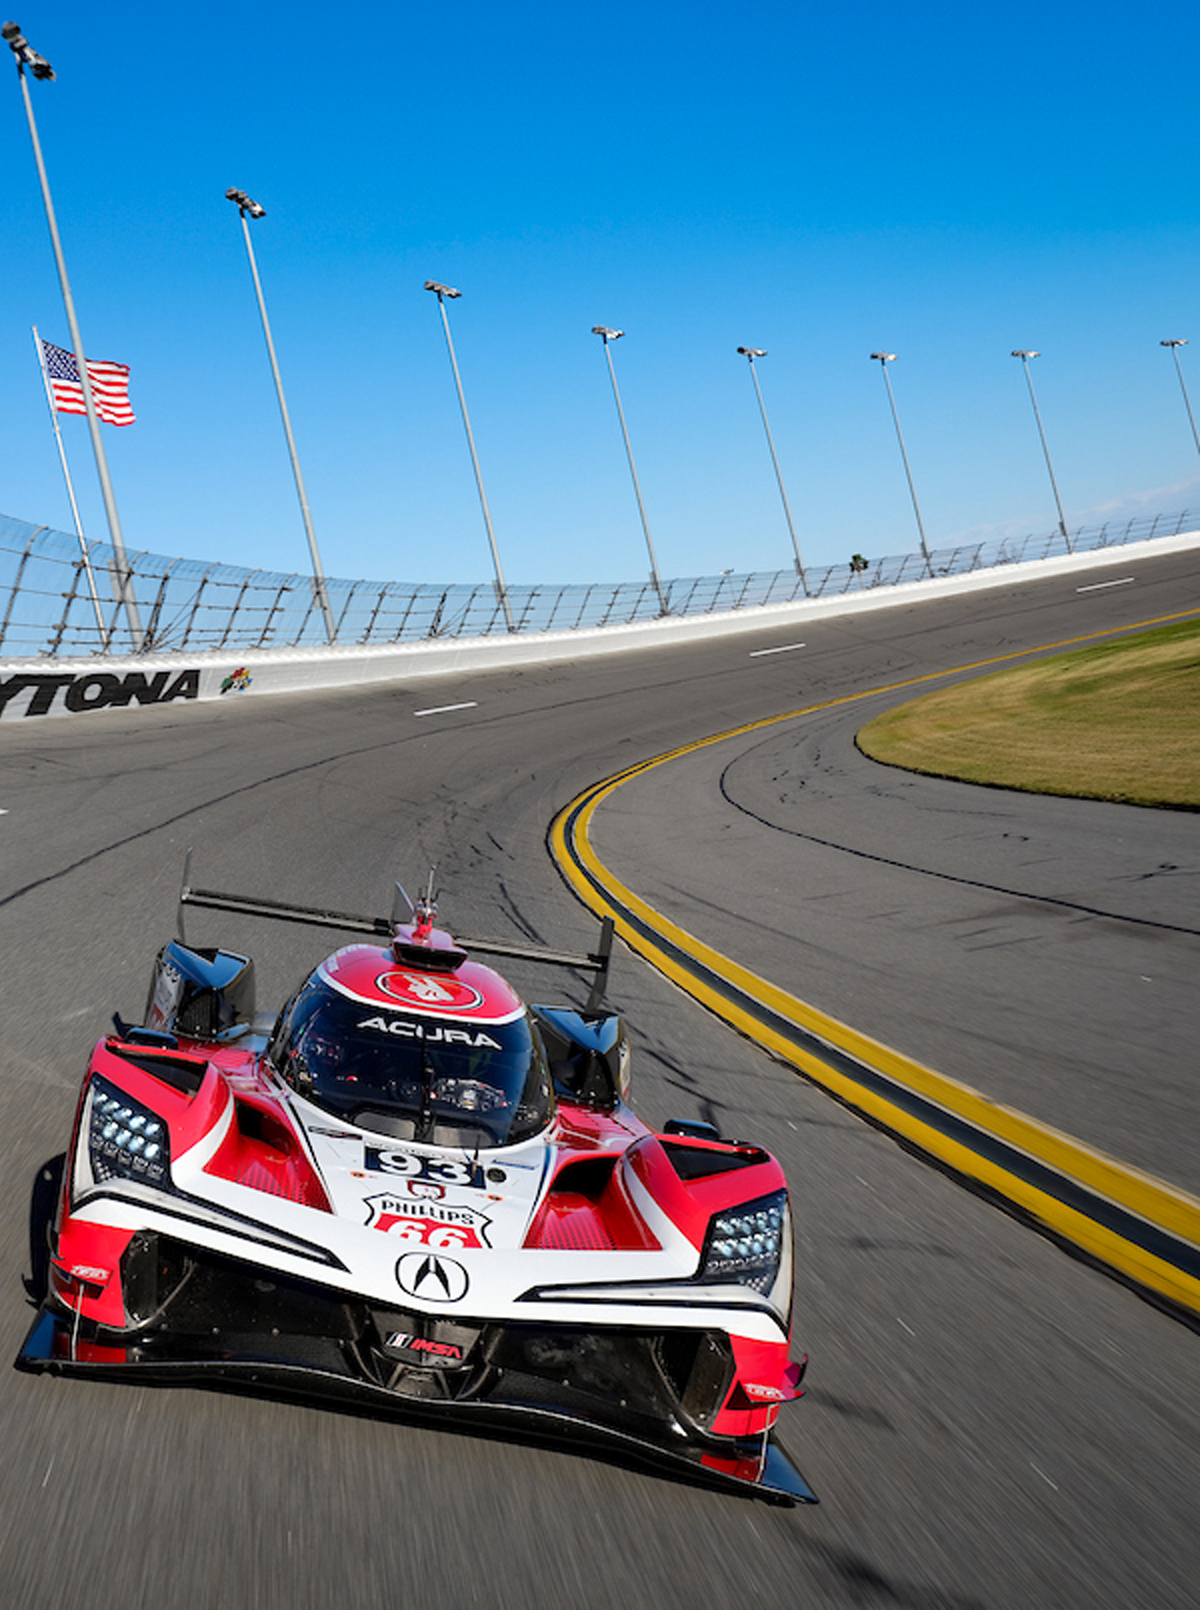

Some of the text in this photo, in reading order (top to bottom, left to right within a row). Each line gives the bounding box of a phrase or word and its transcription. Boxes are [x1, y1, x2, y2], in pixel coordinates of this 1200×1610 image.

[356, 1016, 502, 1050] ACURA
[378, 1150, 472, 1185] 93
[381, 1199, 475, 1226] PHILLIPS
[386, 1219, 469, 1248] 66
[409, 1338, 462, 1360] IMSA
